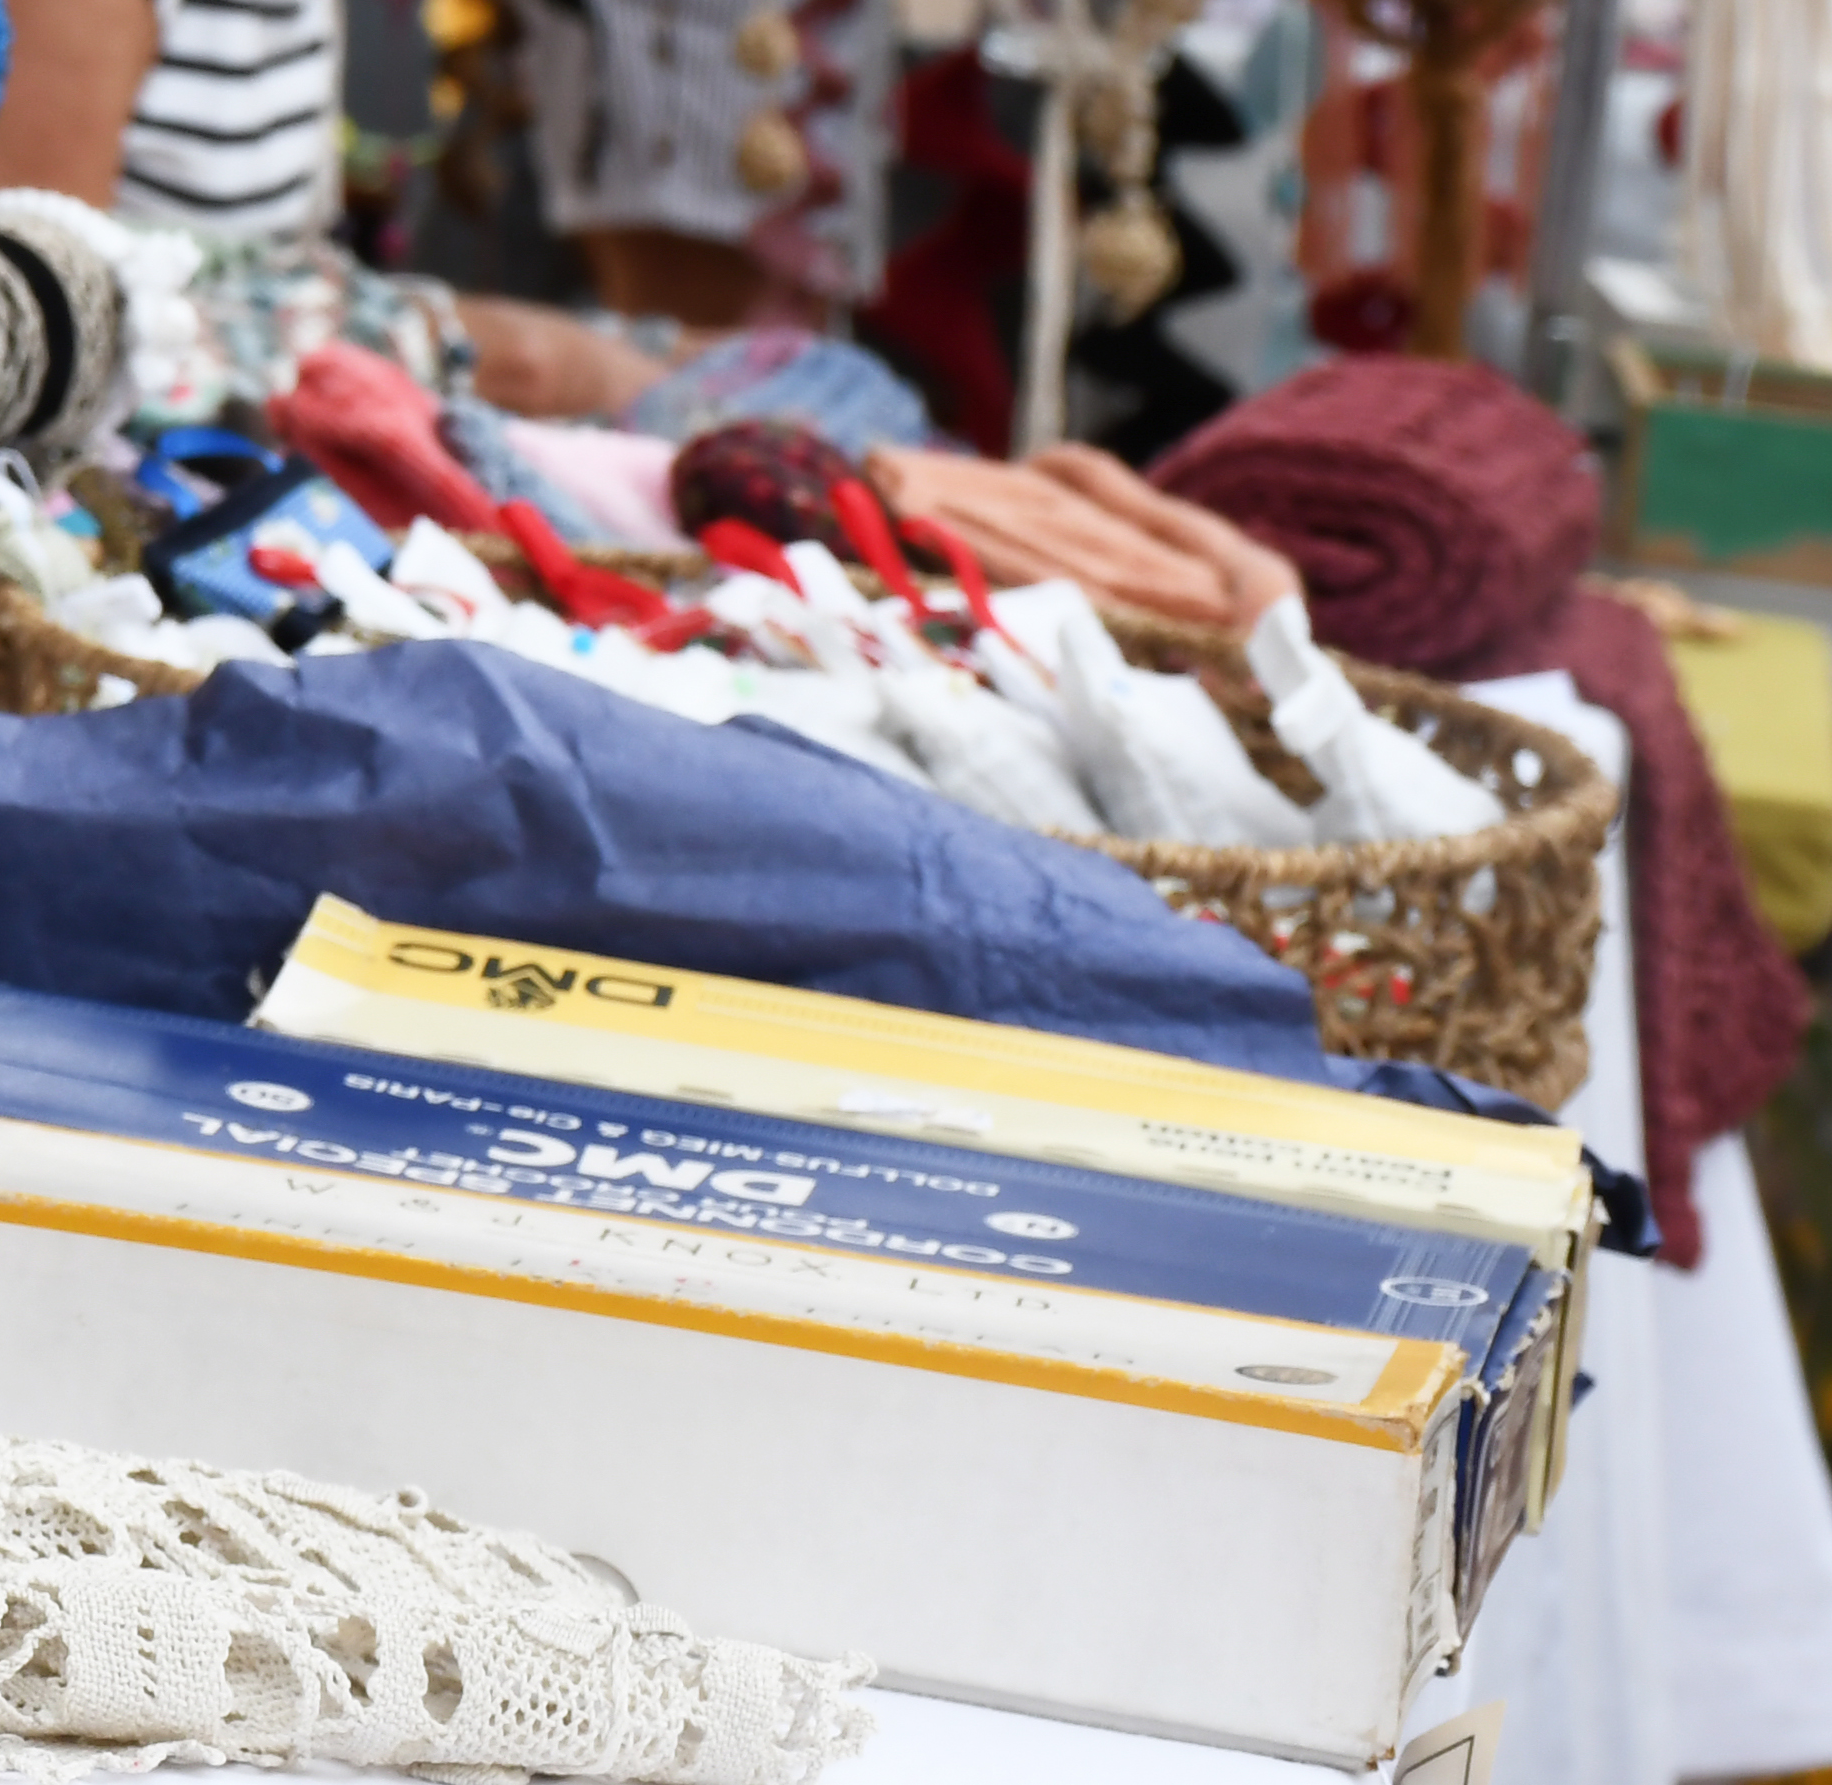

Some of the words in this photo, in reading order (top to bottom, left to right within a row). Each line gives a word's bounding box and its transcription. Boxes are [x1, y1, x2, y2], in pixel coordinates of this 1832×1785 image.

[387, 942, 675, 1008] DMC
[182, 1111, 513, 1195] SPECIAL
[596, 1119, 629, 1139] &
[389, 1146, 682, 1204] CROCHET
[486, 1127, 817, 1207] DMC
[535, 1189, 1074, 1275] CORDONNET
[697, 1195, 868, 1231] POUR
